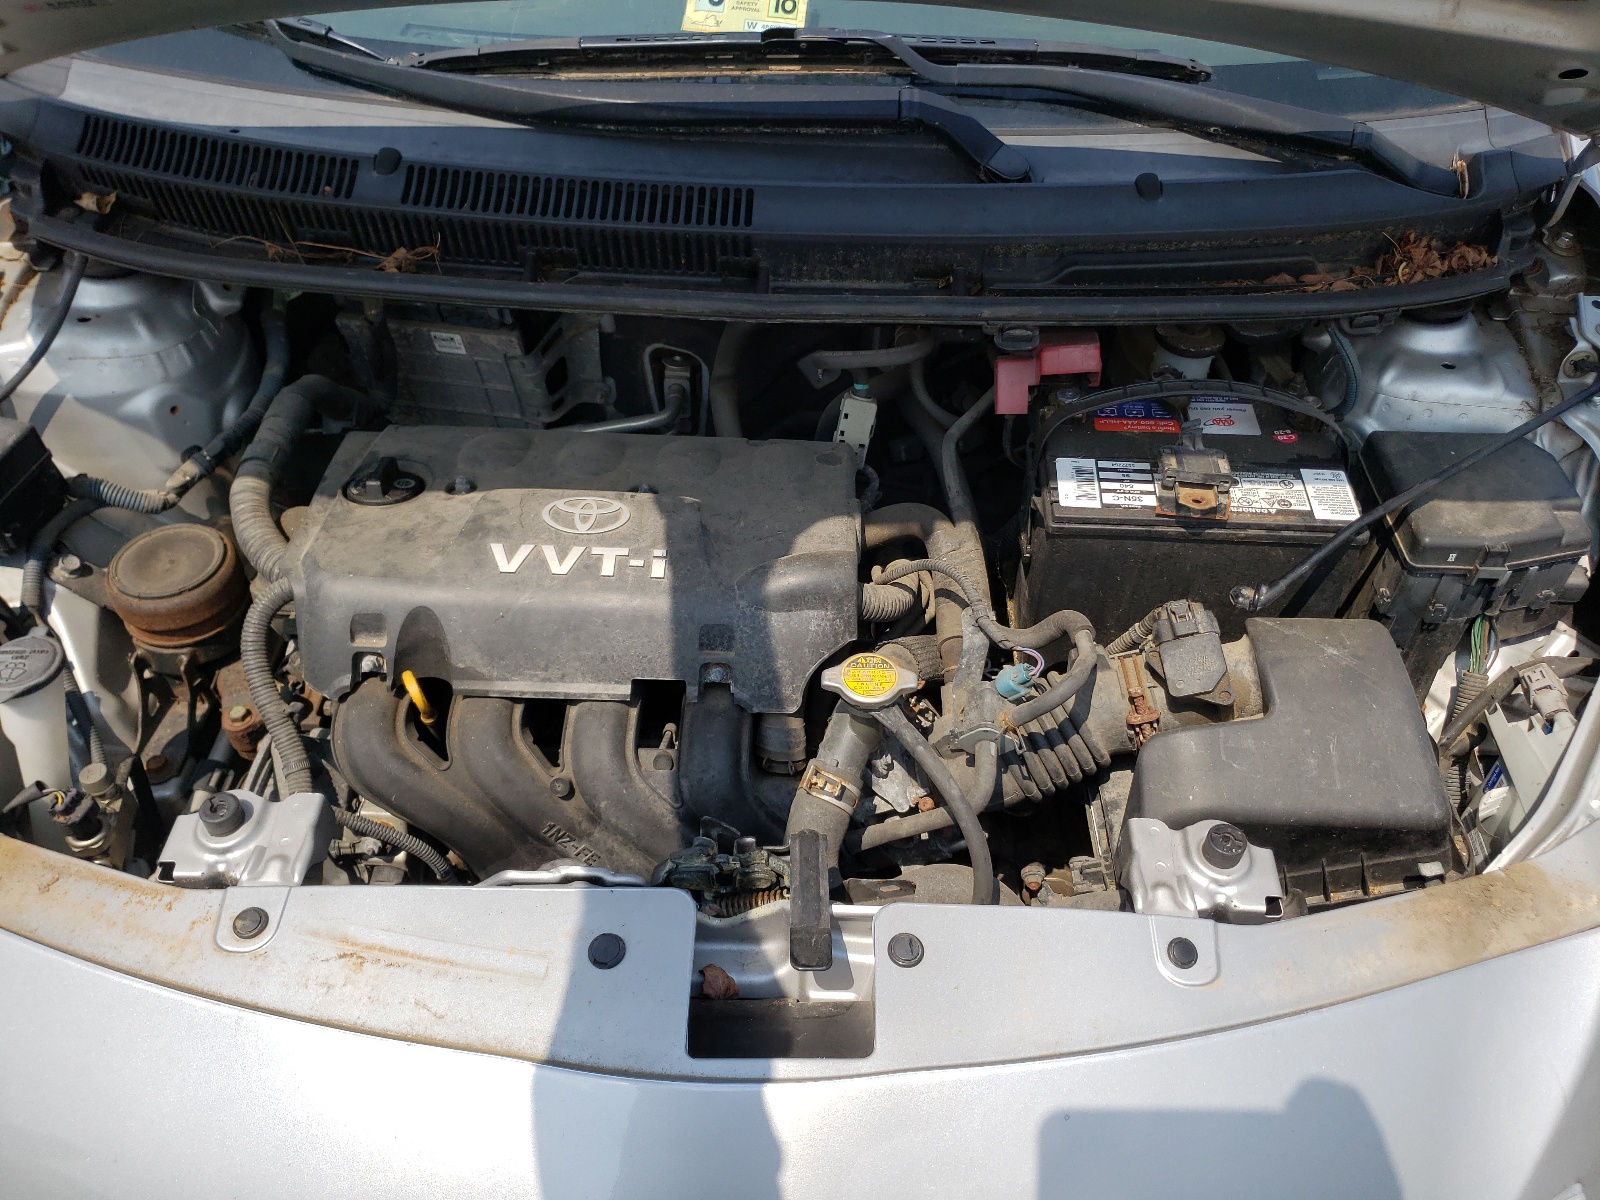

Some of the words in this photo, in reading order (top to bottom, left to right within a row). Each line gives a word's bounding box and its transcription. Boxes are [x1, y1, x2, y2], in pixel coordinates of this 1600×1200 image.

[774, 0, 797, 14] 10
[1213, 418, 1234, 426] AAA
[490, 543, 667, 578] VVT-i
[542, 821, 601, 867] 1NZ-FE
